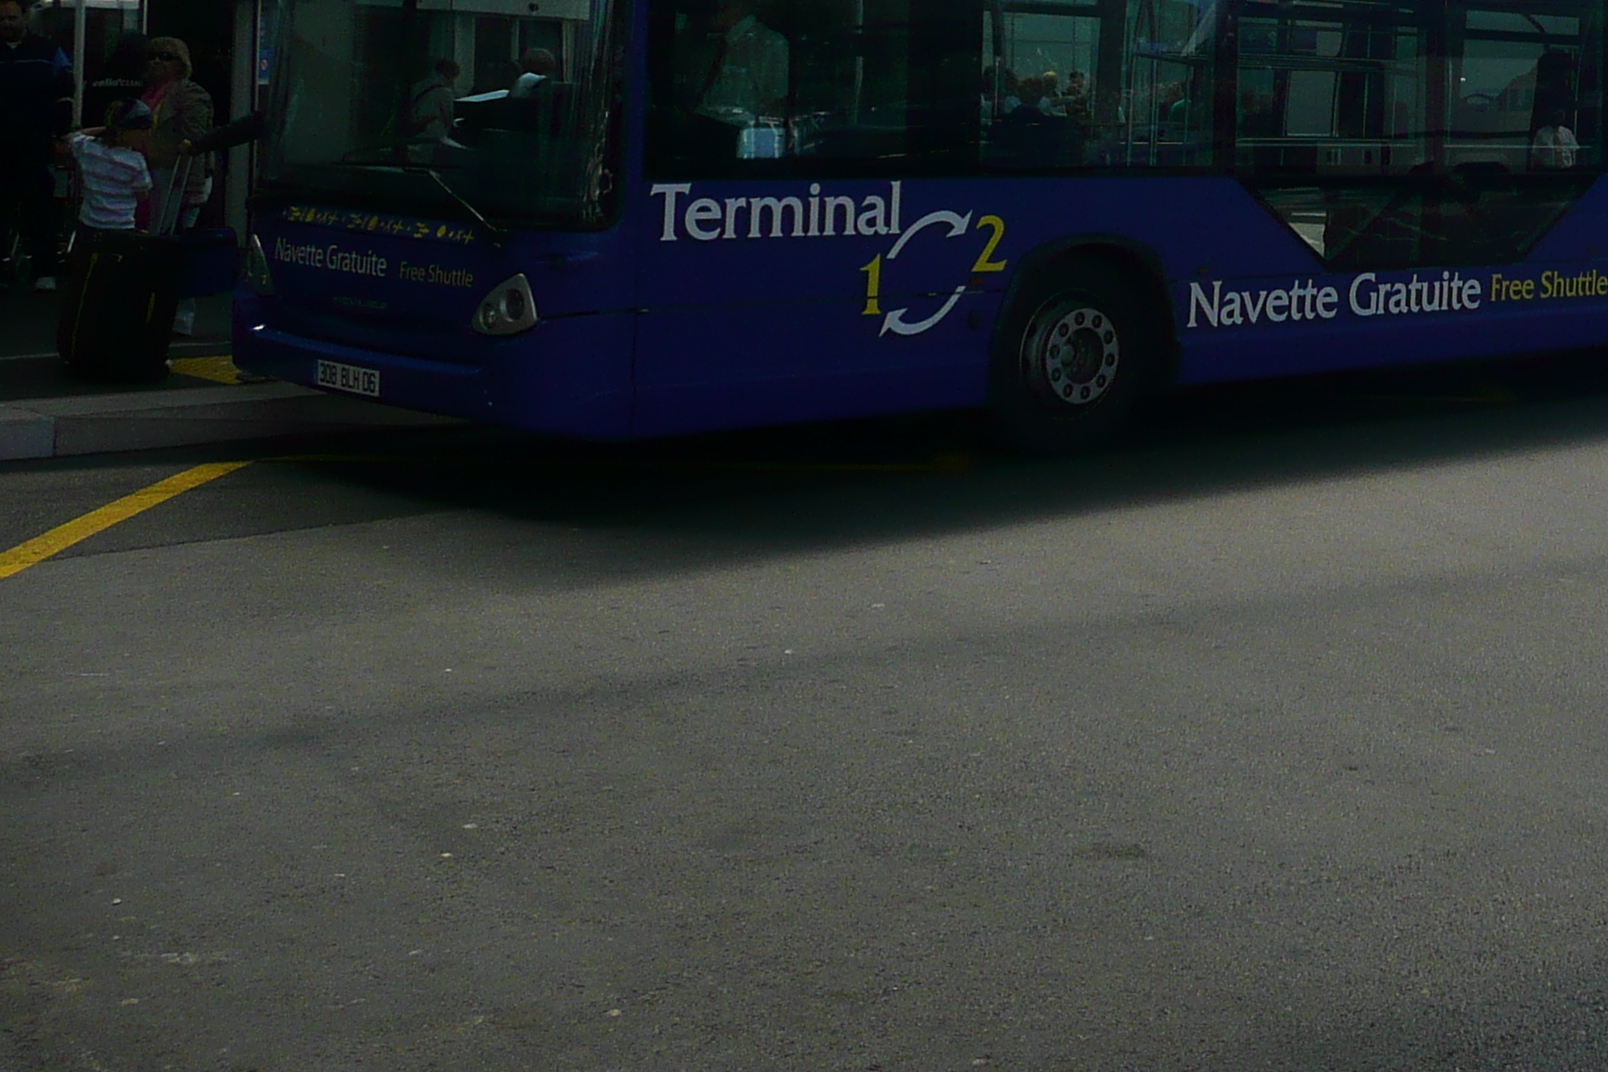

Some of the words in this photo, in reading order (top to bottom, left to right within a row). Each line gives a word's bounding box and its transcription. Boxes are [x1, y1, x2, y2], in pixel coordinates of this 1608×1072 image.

[649, 180, 902, 241] Terminal
[274, 236, 323, 267] Navette
[326, 244, 388, 277] Gratuite
[399, 261, 426, 282] Free
[428, 264, 474, 287] Shuttle
[970, 214, 1008, 273] 2
[858, 253, 882, 316] 1
[1186, 278, 1338, 328] Navette
[1349, 270, 1482, 316] Gratuite
[1490, 273, 1534, 302] Free
[1540, 269, 1608, 300] Shuttle
[363, 371, 376, 393] 06
